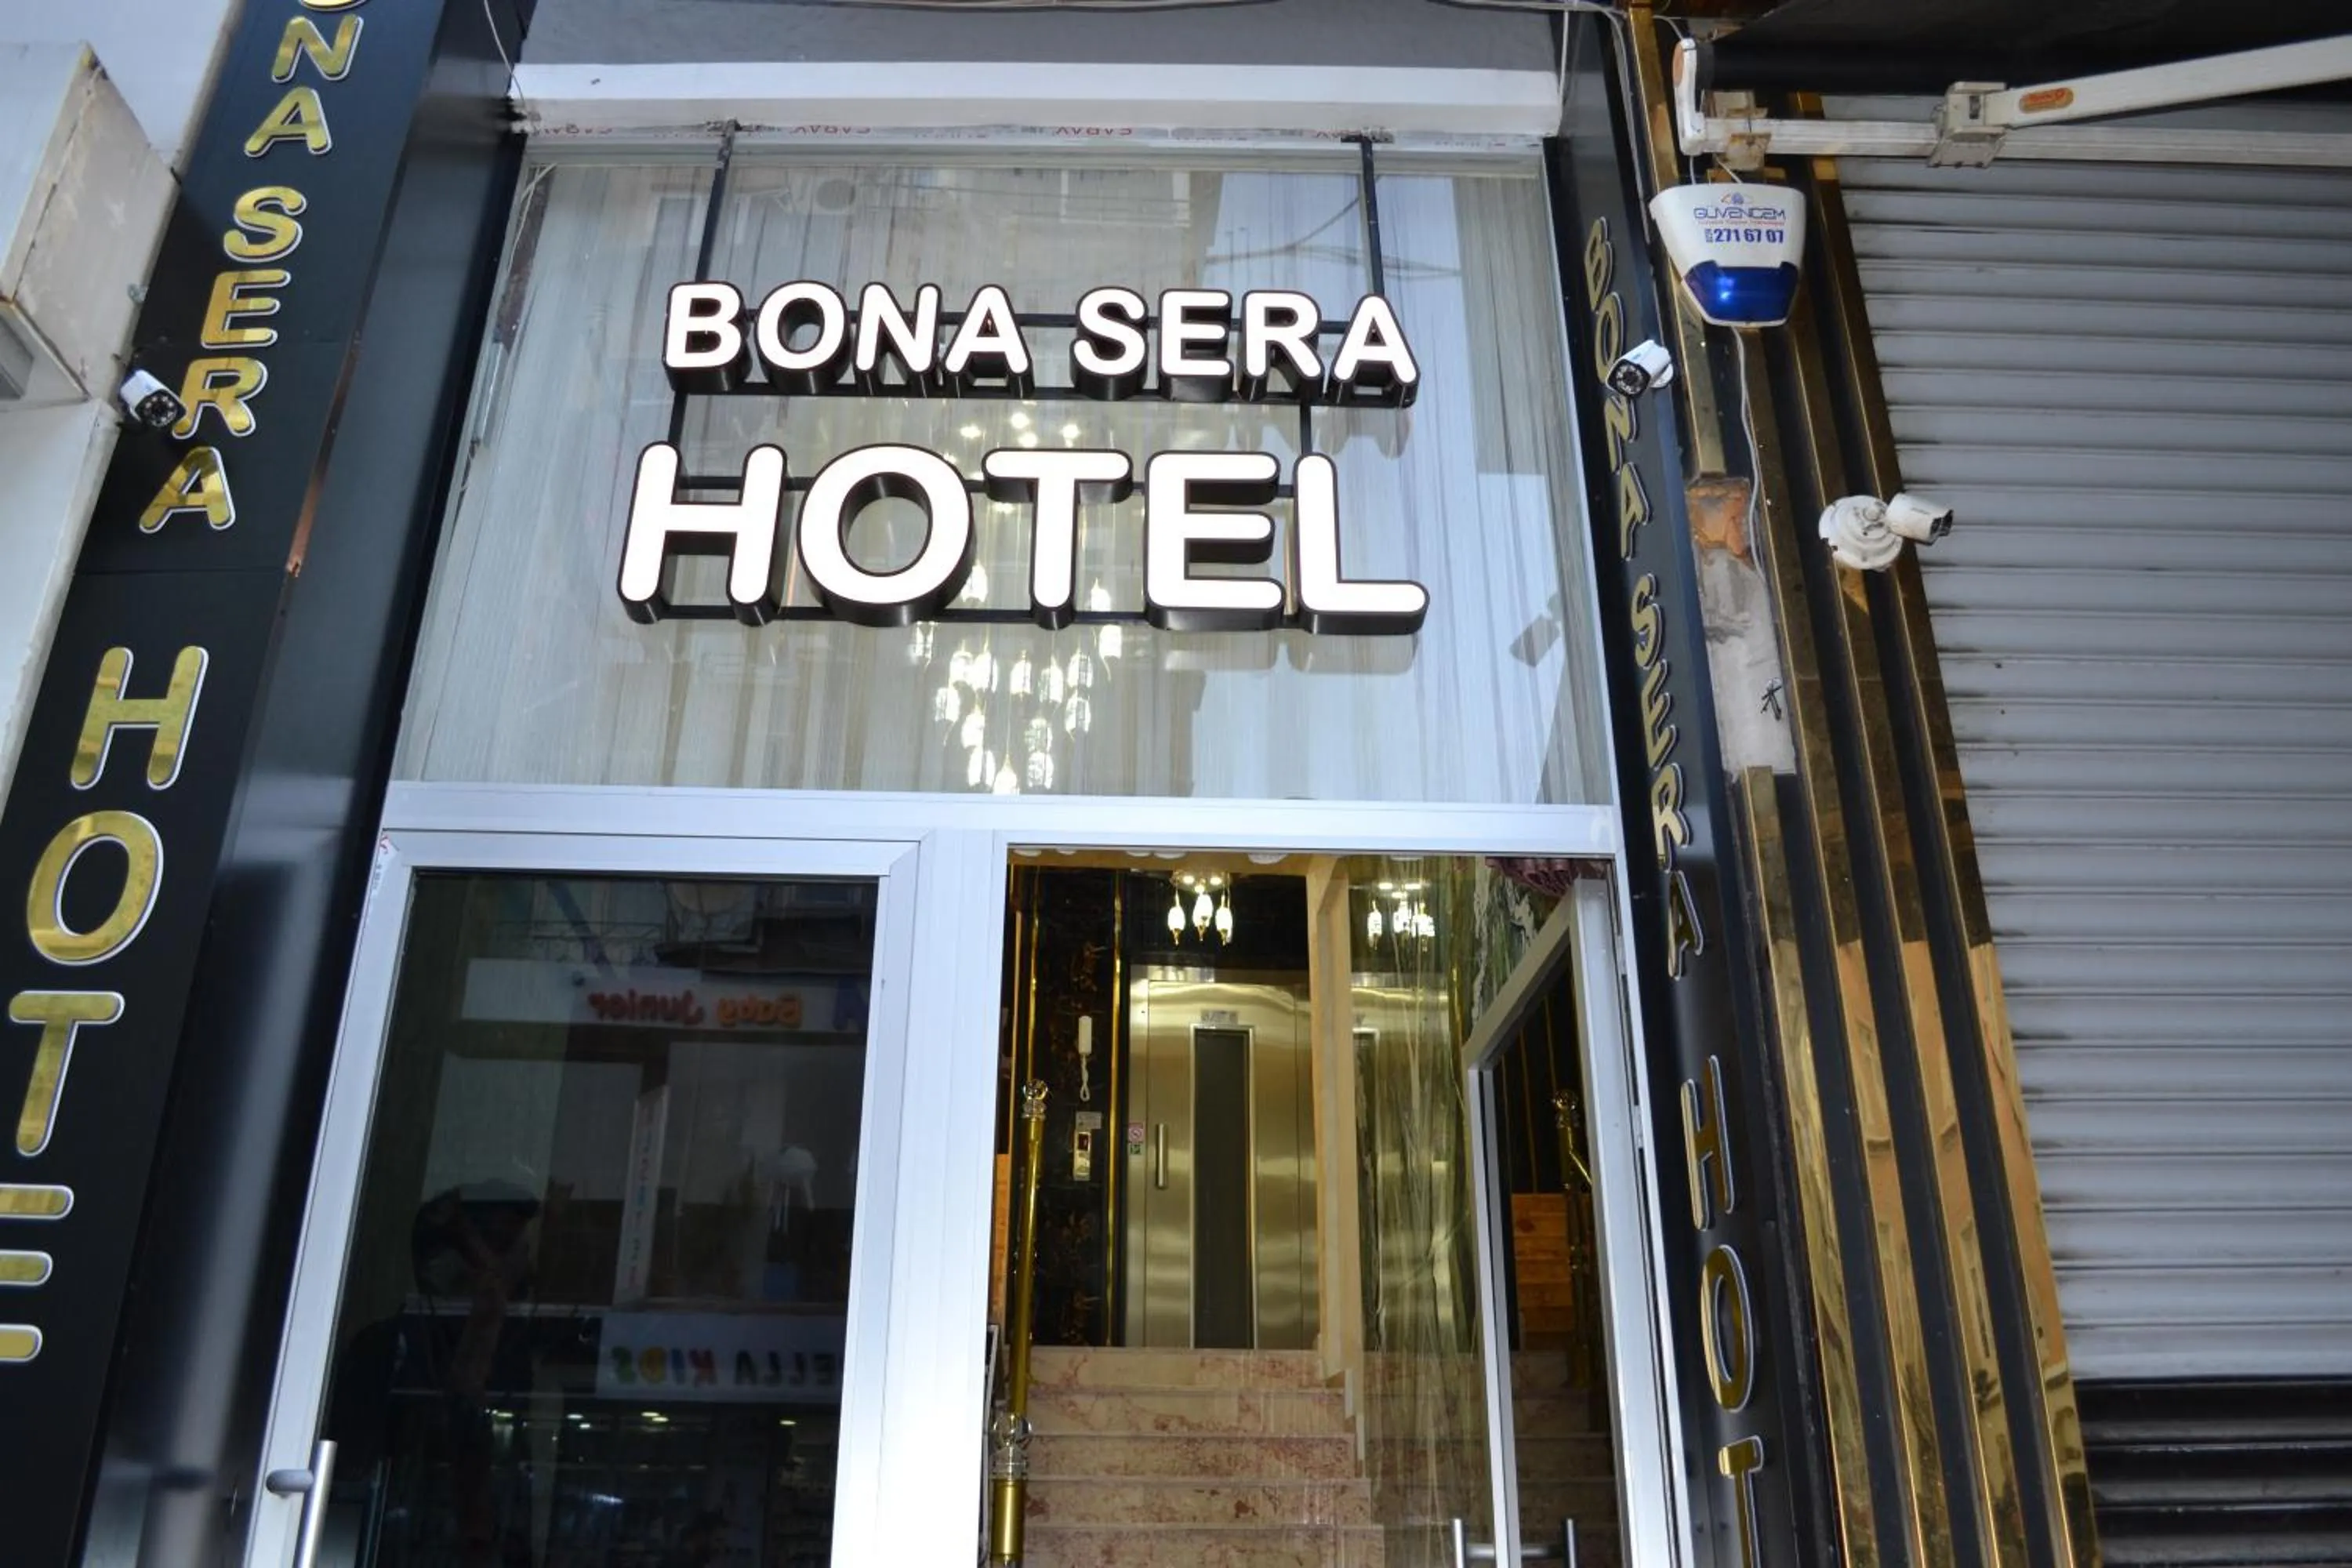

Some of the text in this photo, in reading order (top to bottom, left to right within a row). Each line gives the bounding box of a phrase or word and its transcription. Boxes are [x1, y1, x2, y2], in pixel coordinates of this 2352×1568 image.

[241, 0, 368, 157] NA
[140, 187, 307, 533] SERA
[663, 281, 1419, 394] BONA SERA
[616, 441, 1430, 625] HOTEL
[1584, 216, 1653, 561] BONA
[1631, 572, 1703, 981] SERA
